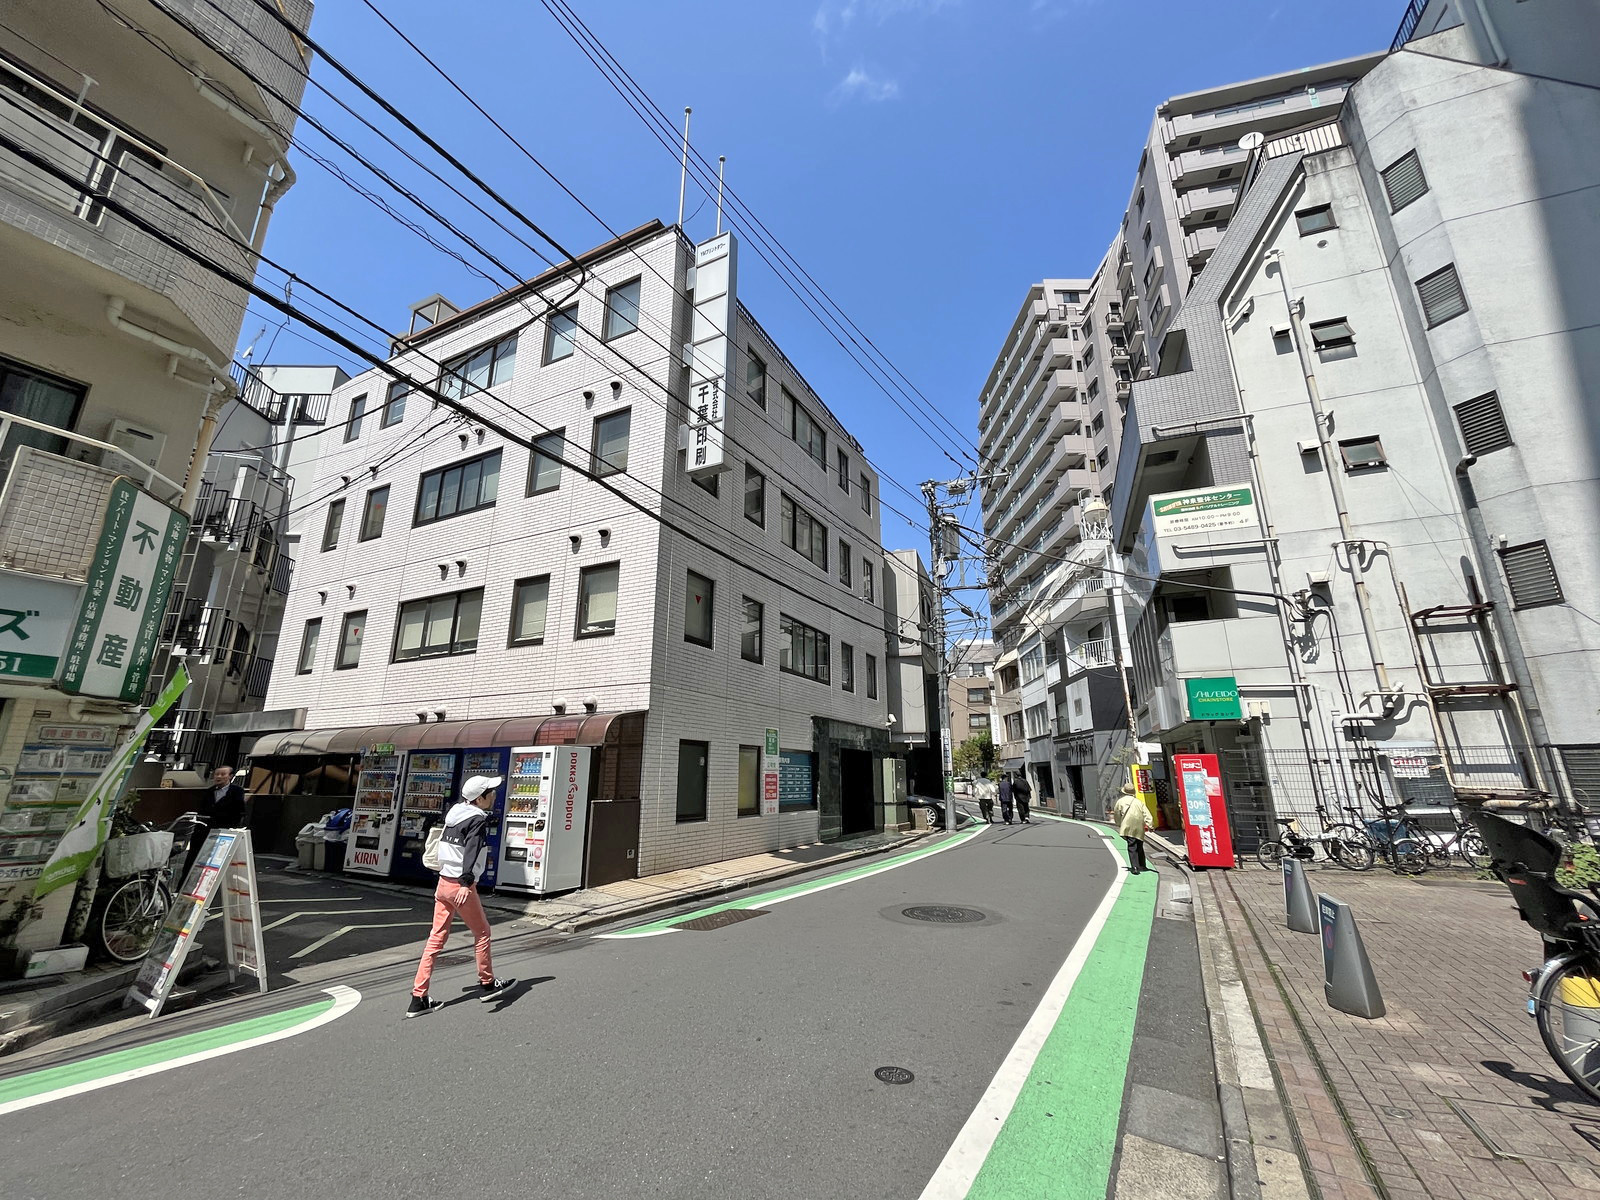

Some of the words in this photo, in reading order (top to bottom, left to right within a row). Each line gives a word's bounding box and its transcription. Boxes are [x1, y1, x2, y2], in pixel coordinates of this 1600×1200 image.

[695, 385, 709, 466] 千葉印刷
[96, 520, 160, 669] 不動産
[1192, 690, 1238, 699] SHISEIDO
[354, 851, 379, 866] KIRIN
